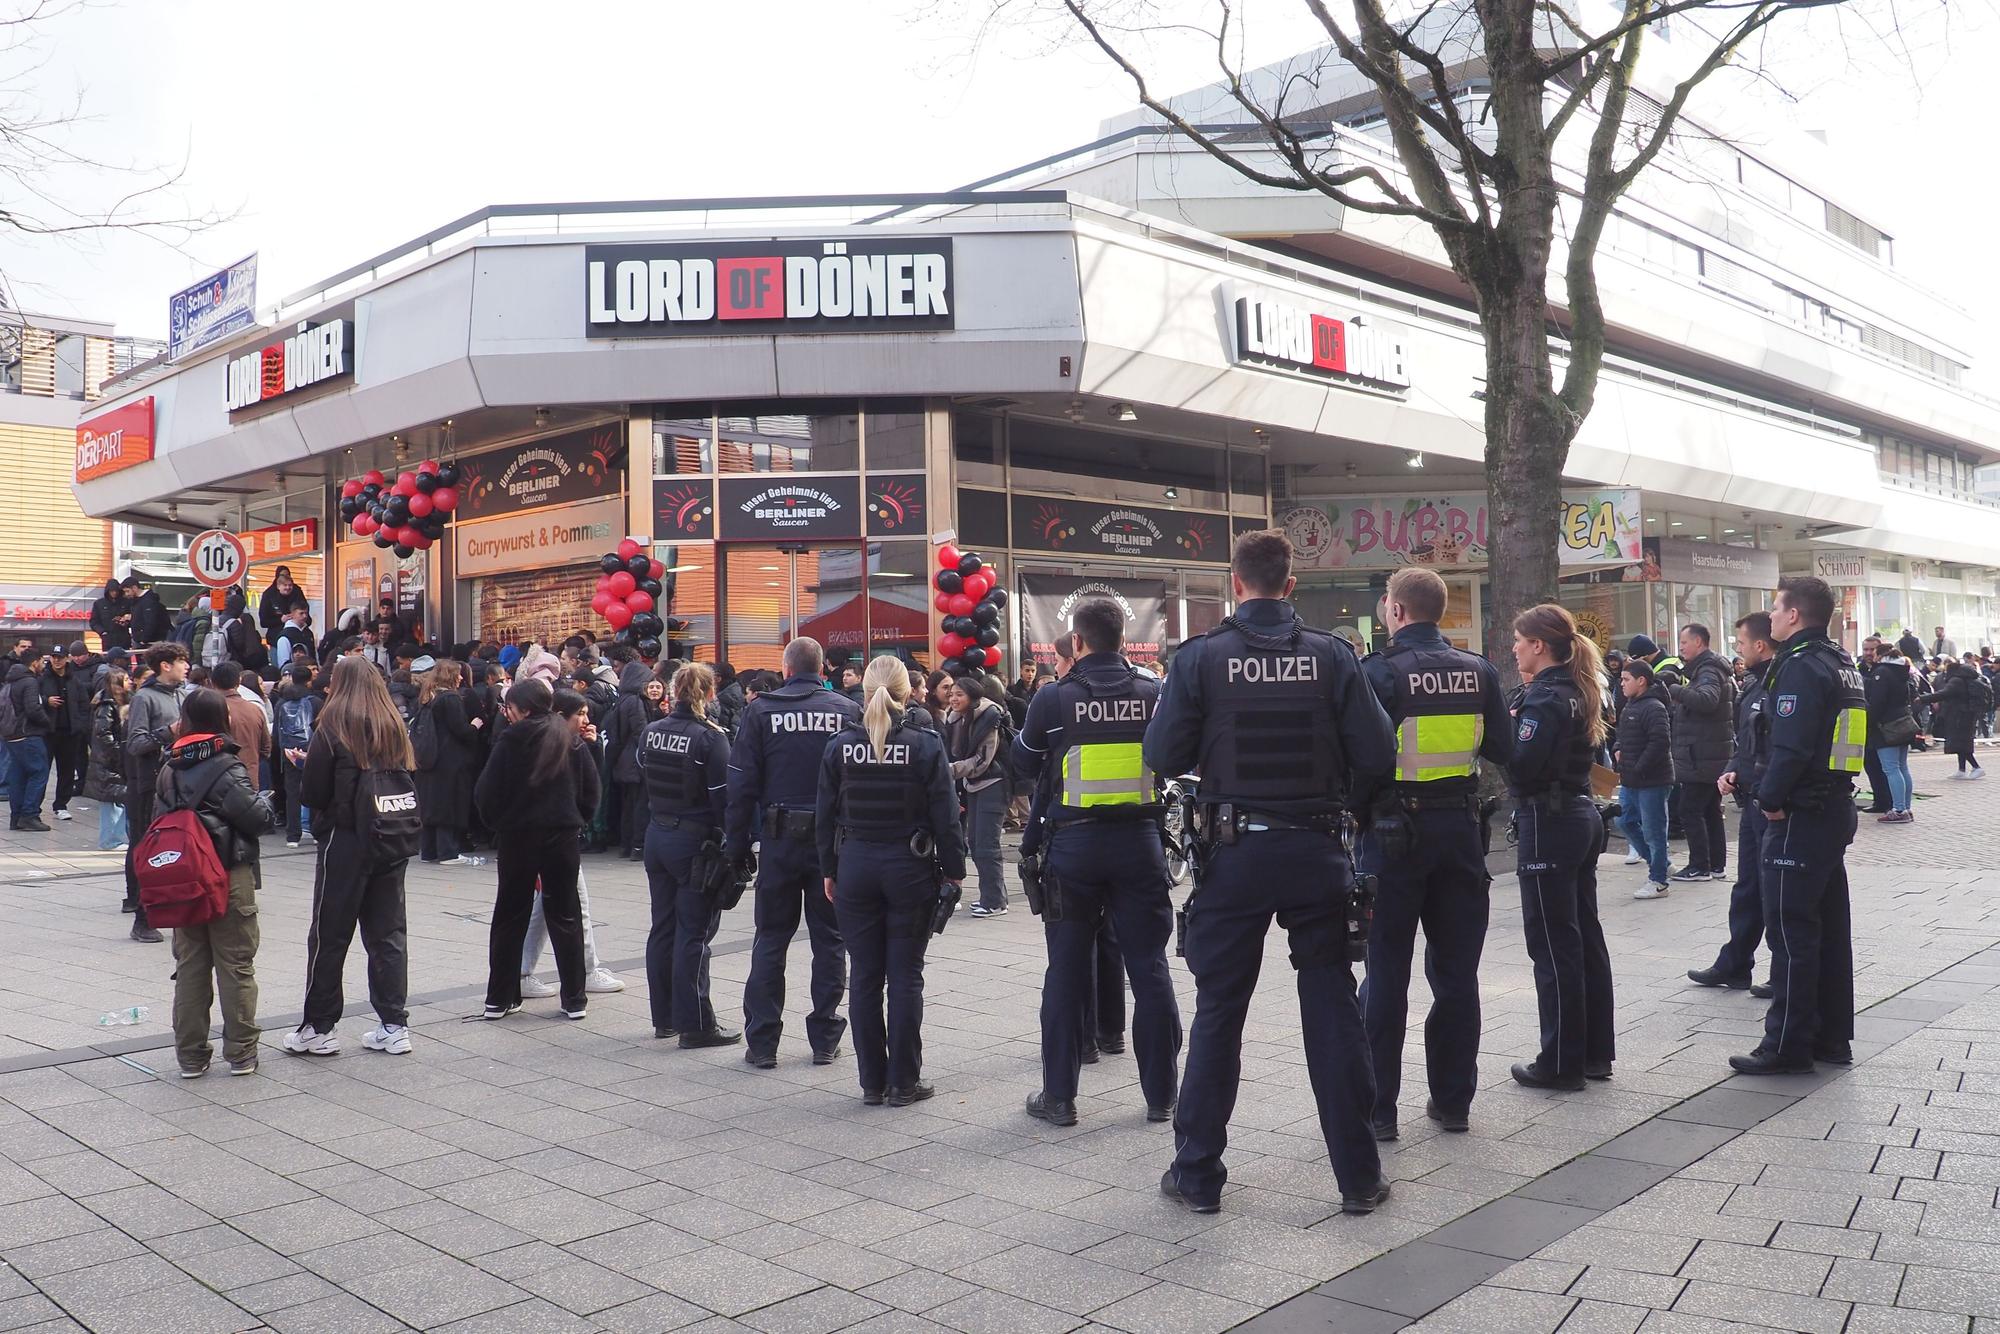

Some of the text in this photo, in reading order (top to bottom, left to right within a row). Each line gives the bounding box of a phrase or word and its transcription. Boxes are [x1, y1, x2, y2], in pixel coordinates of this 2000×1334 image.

[590, 242, 949, 323] LORD OF DÖNER
[1318, 323, 1339, 360] OF
[222, 351, 262, 412] LORD
[284, 319, 344, 392] DÖNER
[499, 462, 519, 489] Unser
[517, 448, 554, 466] Geheimnis
[554, 452, 572, 477] liegt
[508, 475, 560, 496] BERLINER
[520, 493, 548, 505] Saucen
[740, 485, 841, 513] Unser Geheimnis liegt
[754, 508, 827, 519] BERLINER
[772, 517, 810, 527] Saucen
[1090, 514, 1111, 535] Unser
[1110, 509, 1148, 526] Geheimnis
[1351, 501, 1616, 553] BUBBL EA
[467, 522, 611, 559] Currywurst & Pommes
[1101, 532, 1153, 546] BERLINER
[1692, 552, 1752, 573] Haarstudio Freestyle
[1817, 555, 1866, 577] SCHMIDT
[1057, 582, 1136, 622] ERÖFFNUNGSANGEBOT
[1227, 656, 1319, 683] POLIZEI
[1408, 671, 1480, 695] POLIZEI
[770, 712, 842, 733] POLIZEI
[1074, 700, 1146, 723] POLIZEI
[646, 731, 691, 754] POLIZEI
[842, 743, 910, 765] POLZEI
[374, 791, 417, 812] VANS
